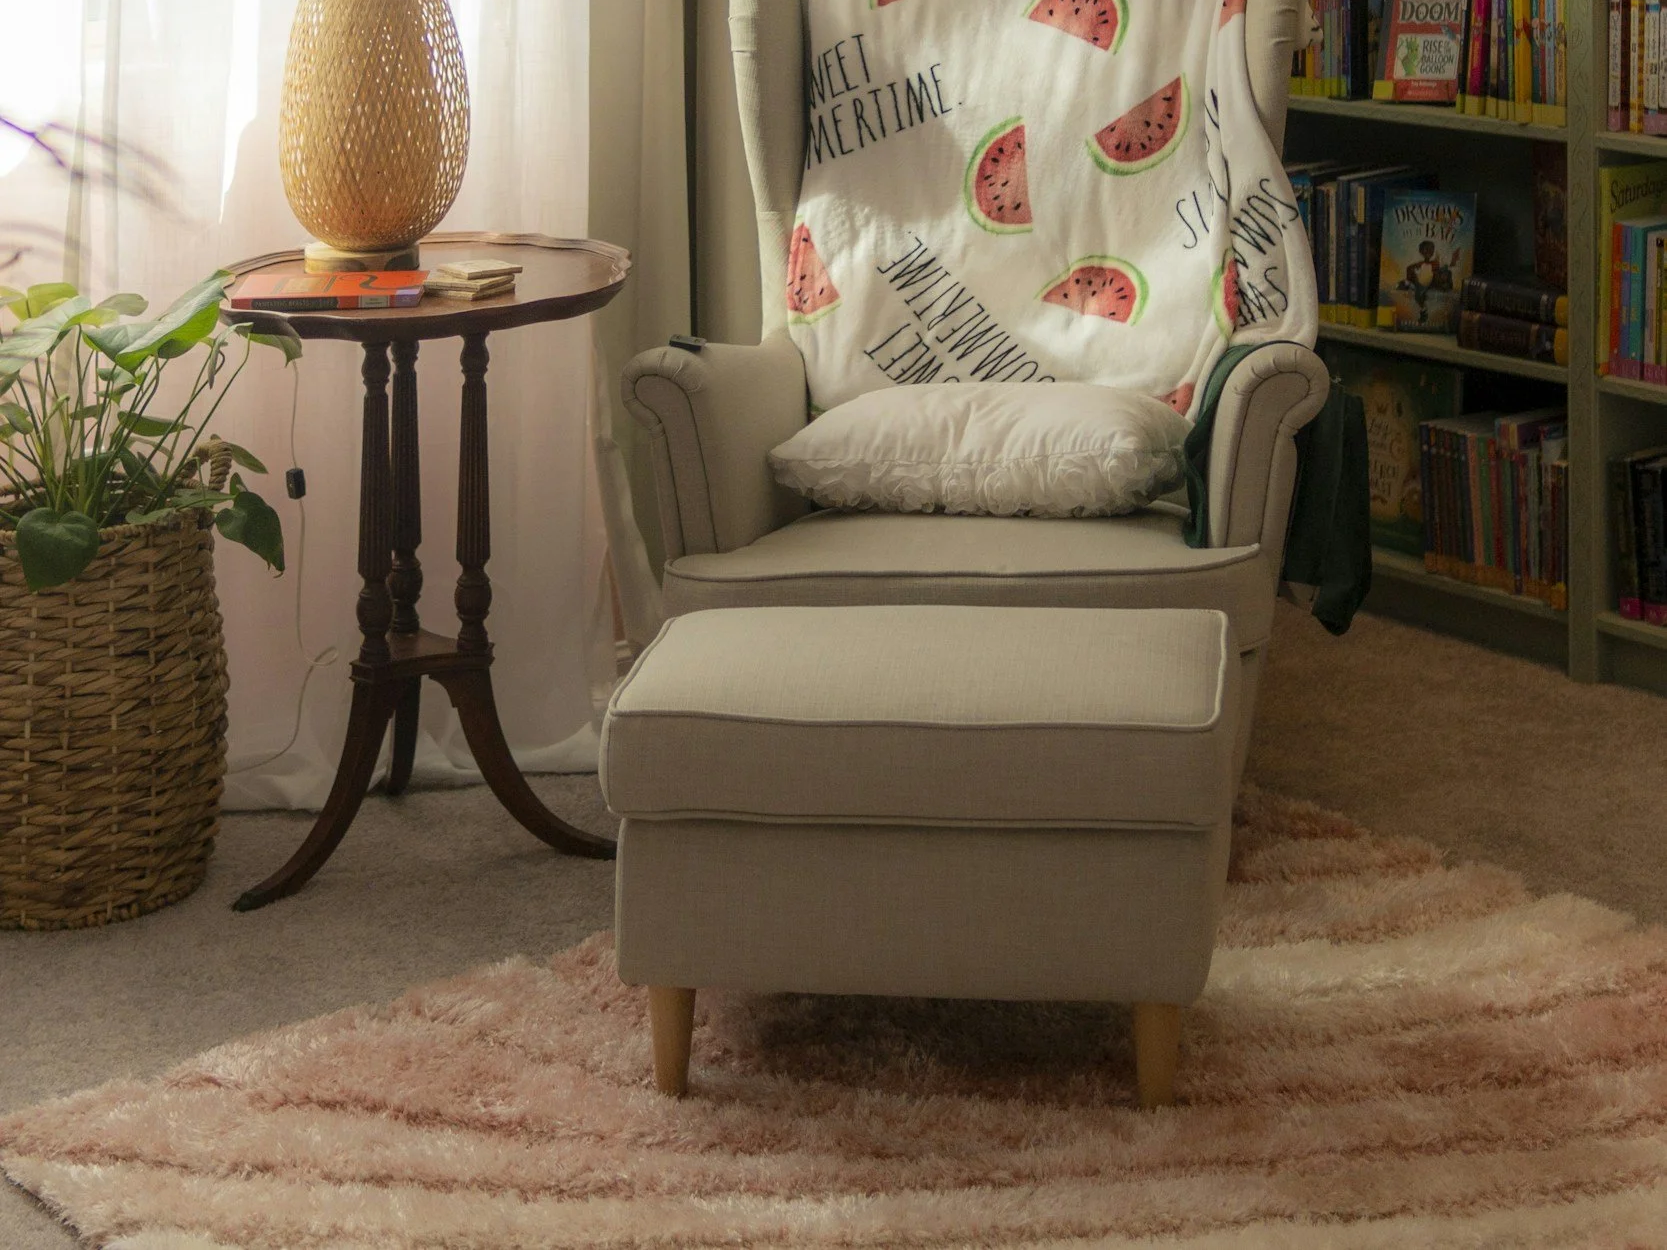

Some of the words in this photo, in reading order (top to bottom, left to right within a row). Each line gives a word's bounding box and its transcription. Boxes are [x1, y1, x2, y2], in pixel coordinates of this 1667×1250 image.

[1401, 1, 1459, 22] DOOM
[1422, 38, 1444, 54] RISE
[1421, 54, 1454, 64] BALLOON
[1420, 64, 1446, 75] GOONS
[1394, 204, 1464, 226] DRAGONS
